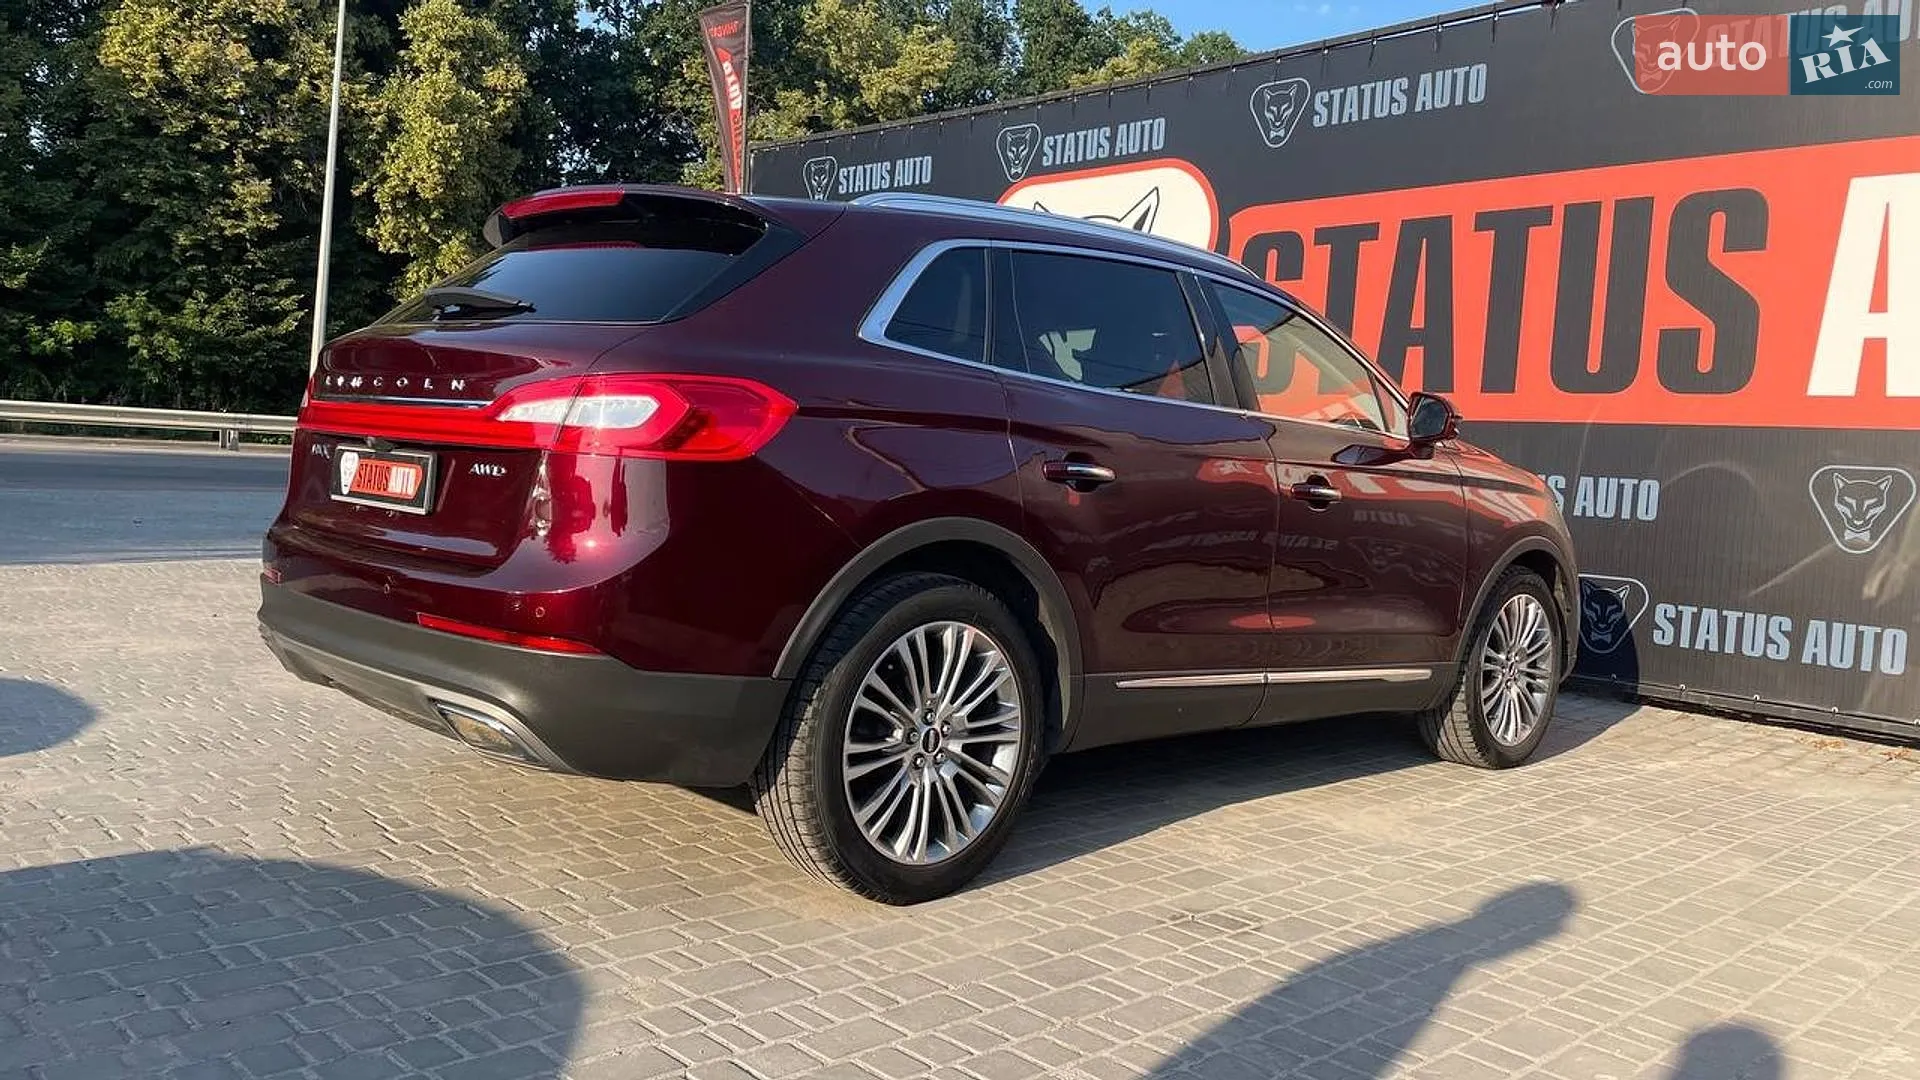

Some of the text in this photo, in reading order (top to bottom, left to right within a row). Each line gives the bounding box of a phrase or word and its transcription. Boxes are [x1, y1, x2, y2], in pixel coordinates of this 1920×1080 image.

[1312, 63, 1488, 128] STATUS AUTO
[1042, 117, 1166, 167] STATUS AUTO
[838, 155, 932, 195] STATUS AUTO
[1241, 187, 1770, 395] STATUS
[356, 463, 417, 495] STATUS AUTO
[468, 463, 507, 478] AWD
[1573, 476, 1660, 520] AUTO
[1652, 603, 1908, 675] STATUS AUTO
